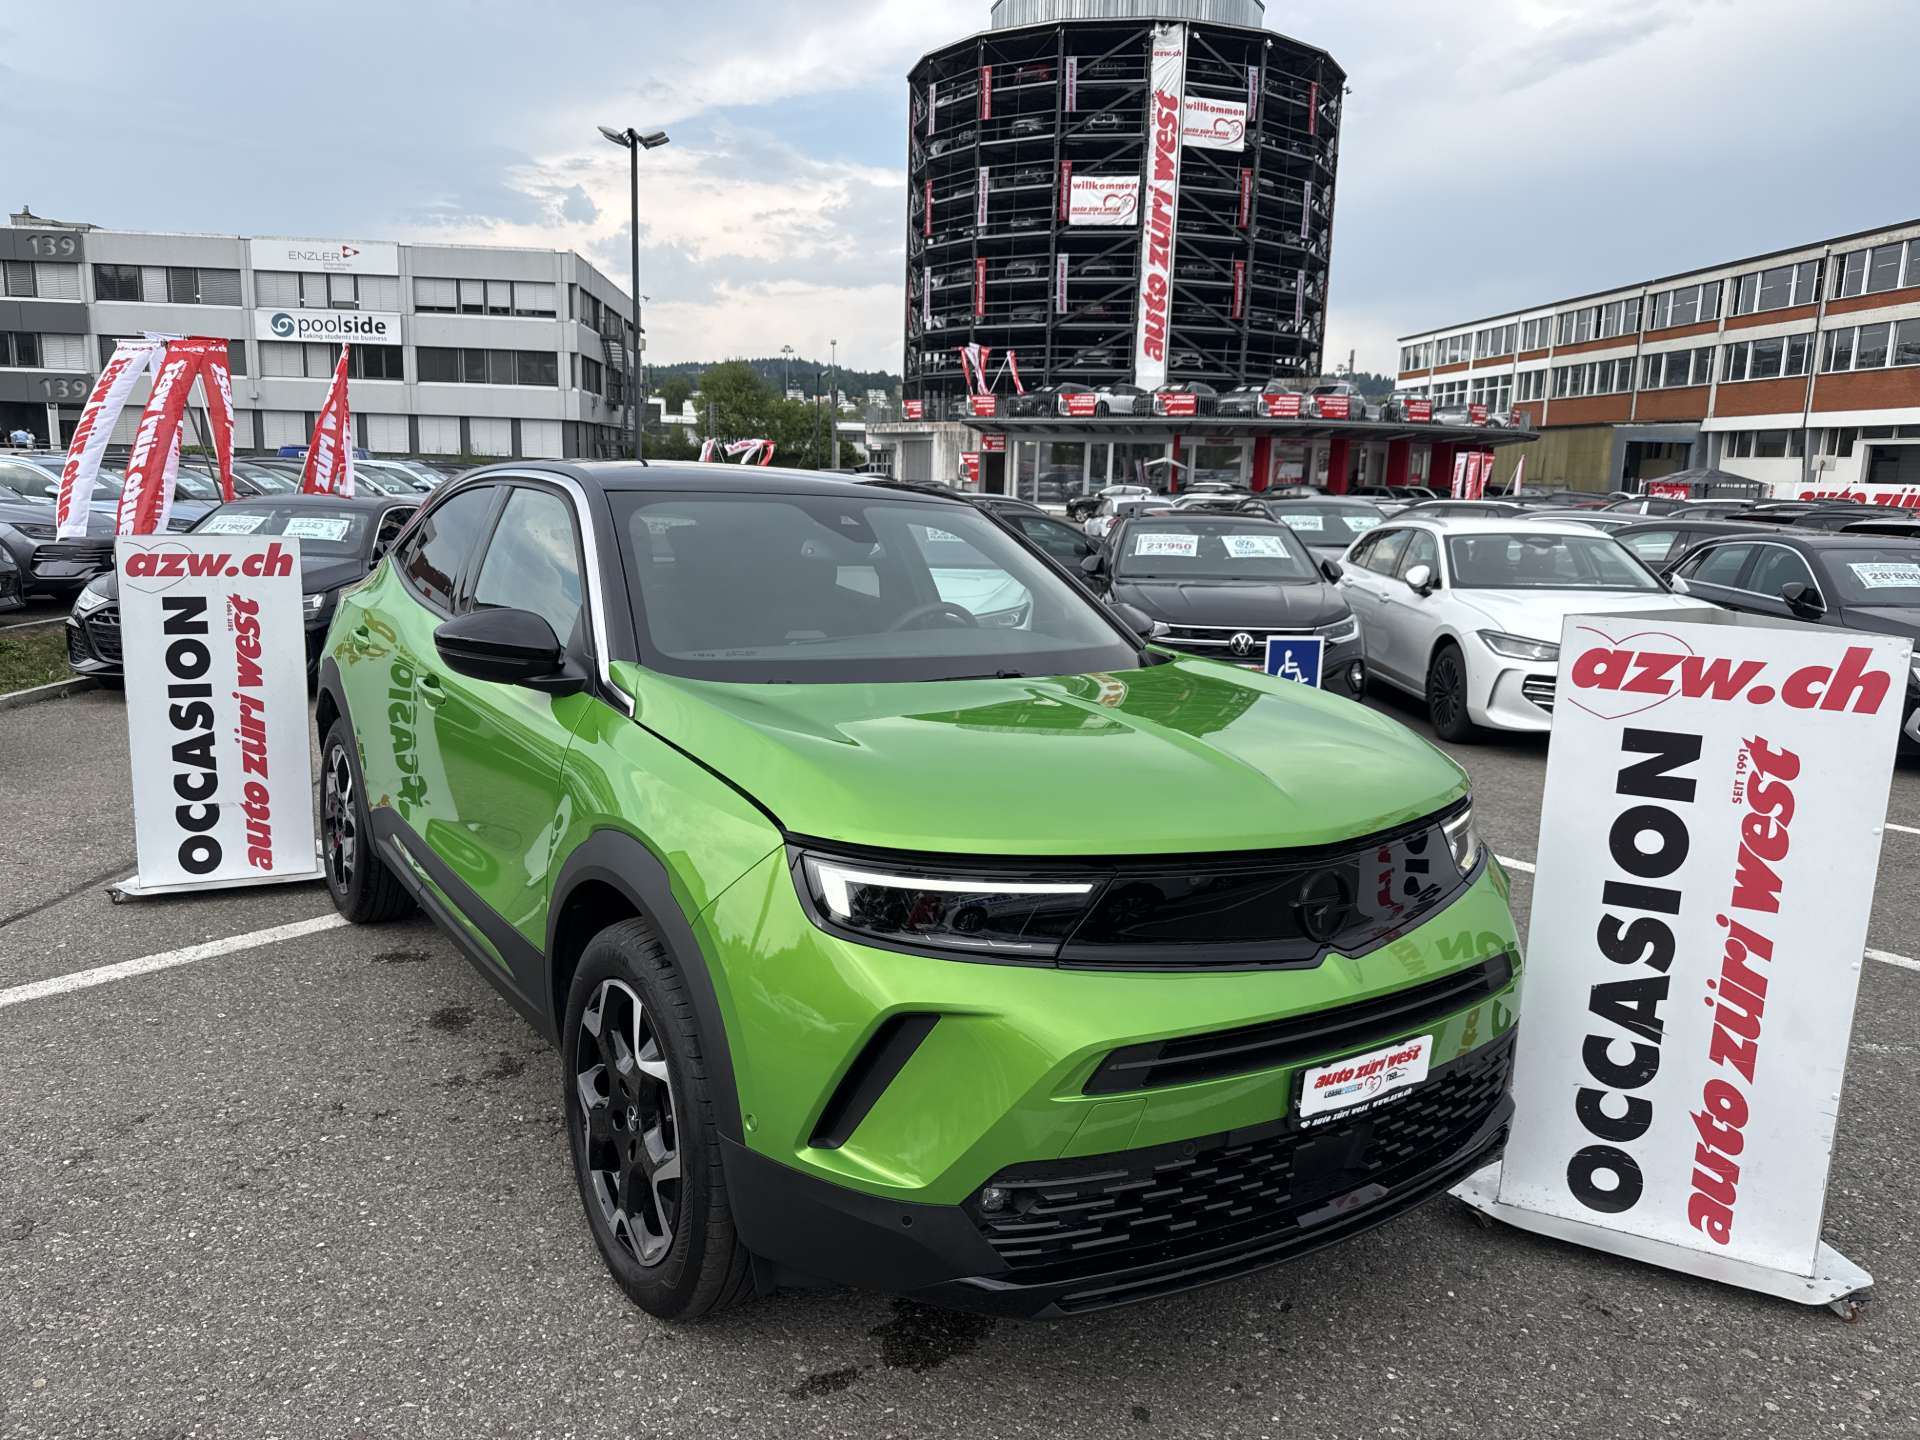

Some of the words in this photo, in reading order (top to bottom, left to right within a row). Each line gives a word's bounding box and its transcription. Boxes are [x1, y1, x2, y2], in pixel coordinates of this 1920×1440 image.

[1153, 49, 1182, 57] azw.ch
[1185, 101, 1245, 116] willkommen
[1153, 89, 1178, 181] west
[1073, 181, 1137, 190] willkommen
[26, 235, 76, 256] 139
[1145, 183, 1174, 273] züri
[288, 250, 341, 262] ENZLER
[298, 314, 387, 338] poolside
[325, 333, 351, 341] students
[361, 334, 388, 342] business
[1143, 273, 1168, 362] auto
[40, 378, 87, 398] 139
[314, 432, 336, 492] züri
[125, 543, 294, 577] azw.ch
[1146, 542, 1192, 551] 23'950
[226, 593, 264, 688] west
[1572, 646, 1891, 715] azw.ch
[162, 596, 222, 874] OCCASION
[232, 692, 268, 780] züri
[1736, 748, 1749, 776] 1991
[1731, 780, 1743, 805] SEIT
[240, 781, 273, 871] auto
[1731, 734, 1801, 914] west
[1567, 727, 1703, 1214] OCCASION
[1703, 912, 1774, 1085] züri
[1314, 1067, 1354, 1089] auto
[1354, 1055, 1388, 1080] züri
[1387, 1045, 1422, 1068] west
[1312, 1115, 1332, 1127] auto
[1332, 1109, 1351, 1121] züri
[1351, 1103, 1369, 1115] west
[1687, 1078, 1753, 1246] auto
